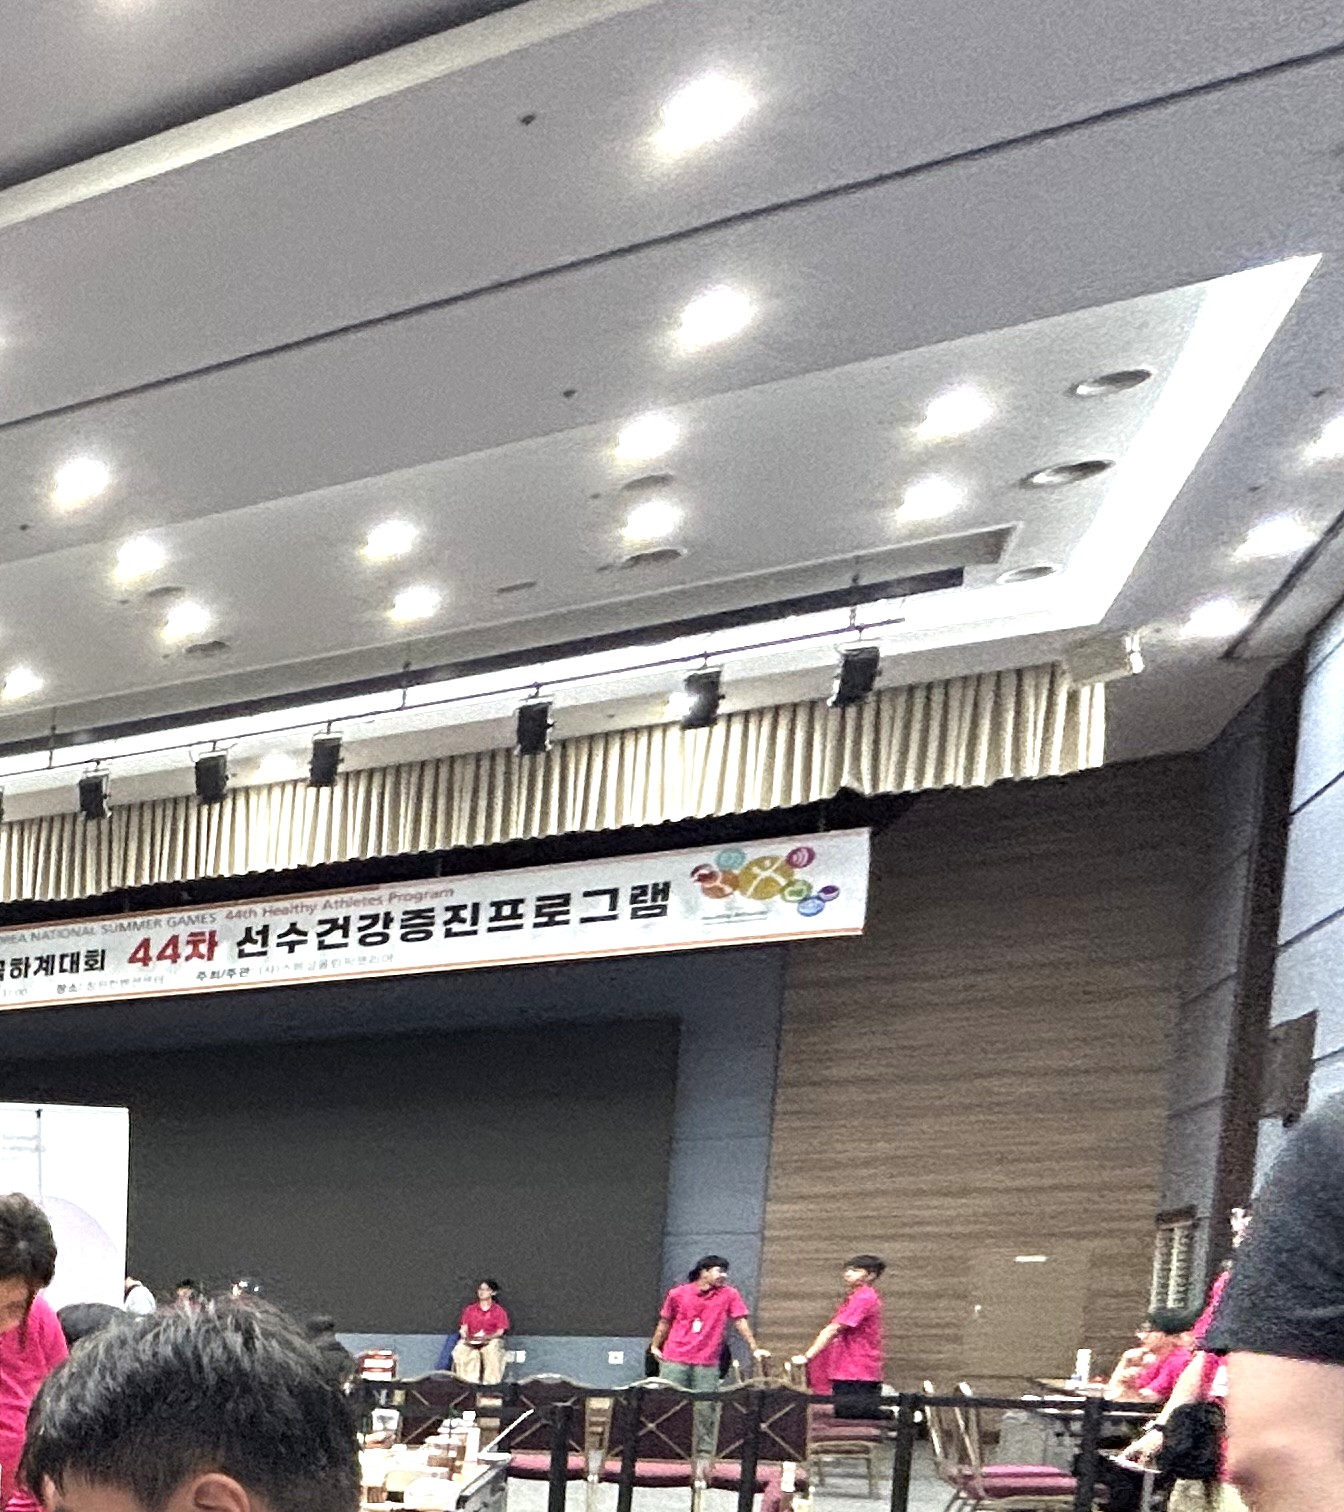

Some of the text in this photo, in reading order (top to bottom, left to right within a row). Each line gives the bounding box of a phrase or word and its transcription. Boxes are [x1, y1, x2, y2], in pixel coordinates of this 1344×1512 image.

[31, 926, 96, 943] NATIONAL
[100, 919, 163, 935] SUMMER
[166, 912, 217, 928] GAMES
[225, 907, 258, 920] 44th
[262, 902, 317, 918] Healthy
[322, 895, 383, 911] Athletes
[388, 887, 454, 904] Program
[127, 929, 219, 968] 44차
[235, 880, 672, 960] 선수건강증진프로그램
